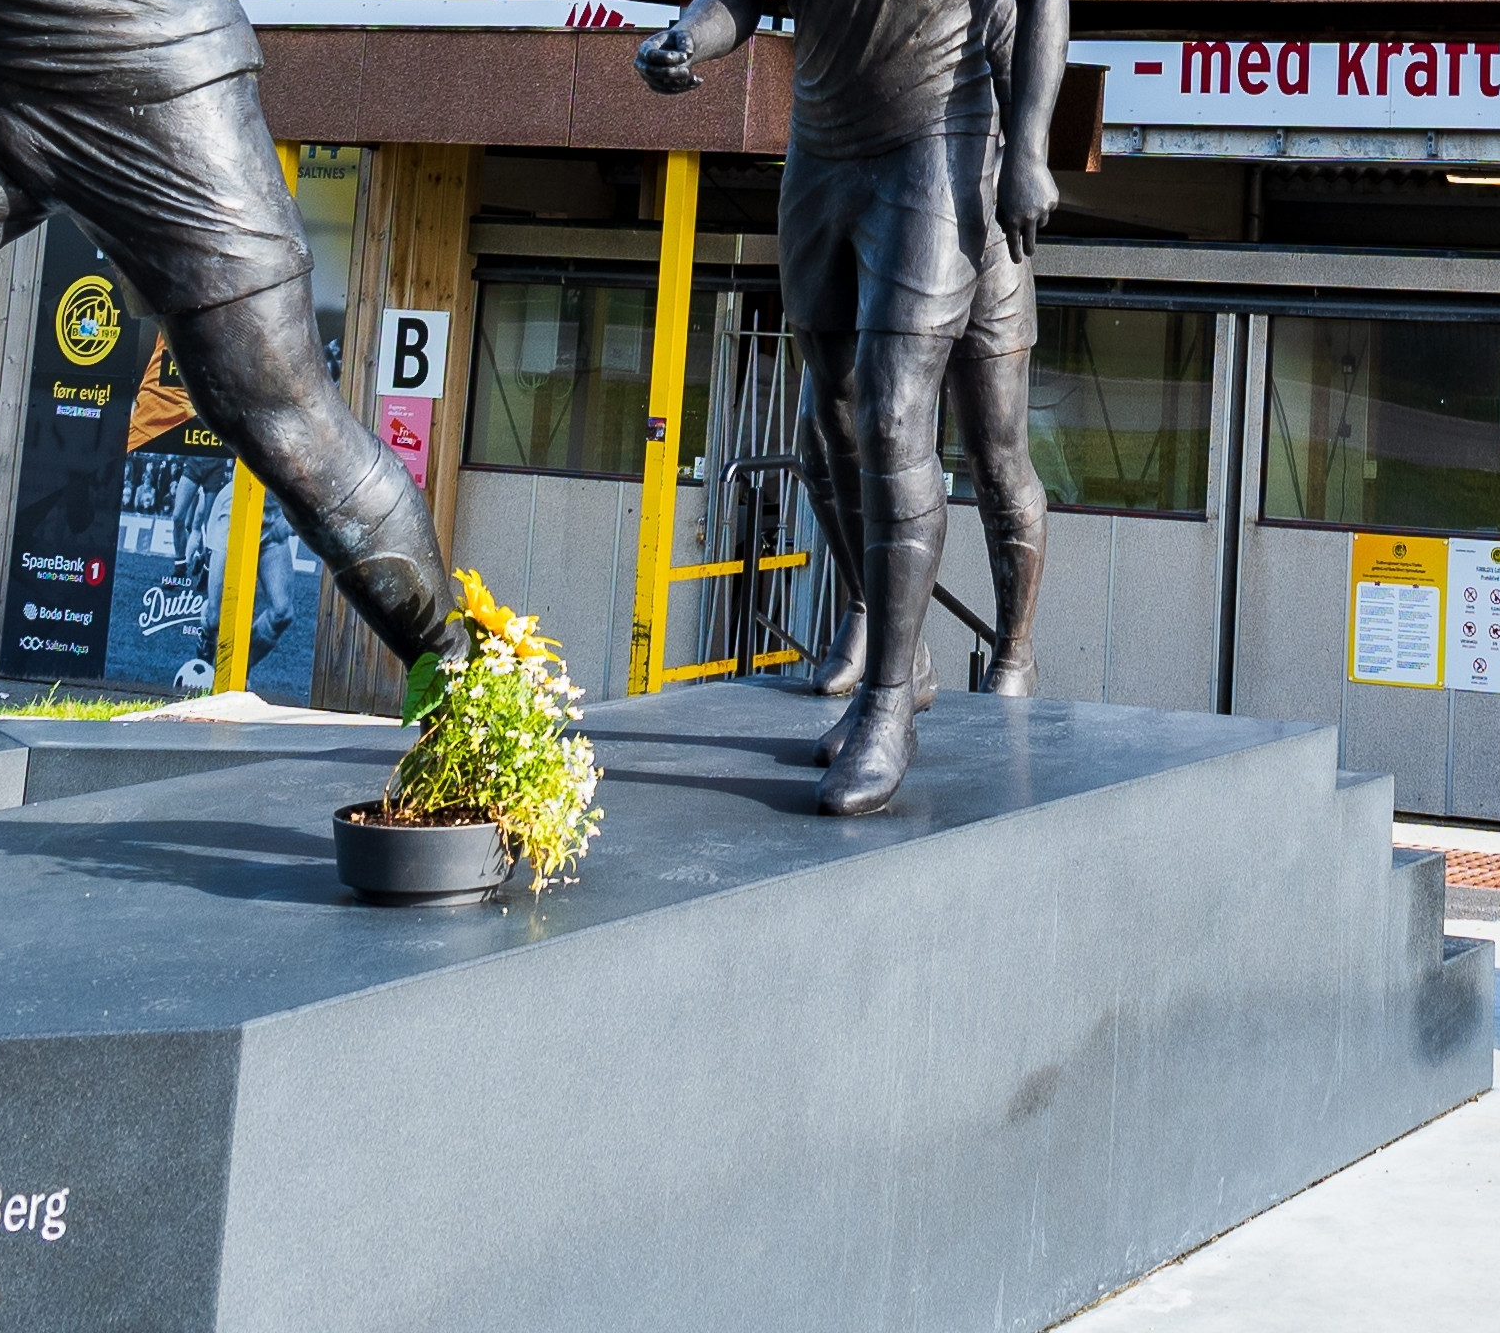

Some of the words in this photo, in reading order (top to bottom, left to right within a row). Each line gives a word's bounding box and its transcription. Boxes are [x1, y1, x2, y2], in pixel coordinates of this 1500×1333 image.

[392, 316, 430, 389] B
[53, 381, 77, 400] førr
[80, 383, 112, 406] evig!
[184, 428, 223, 447] LEGE
[21, 552, 85, 573] SpareBank
[91, 562, 100, 580] 1
[161, 575, 192, 588] HARALD
[64, 609, 94, 626] Energi
[138, 586, 204, 629] Dutte
